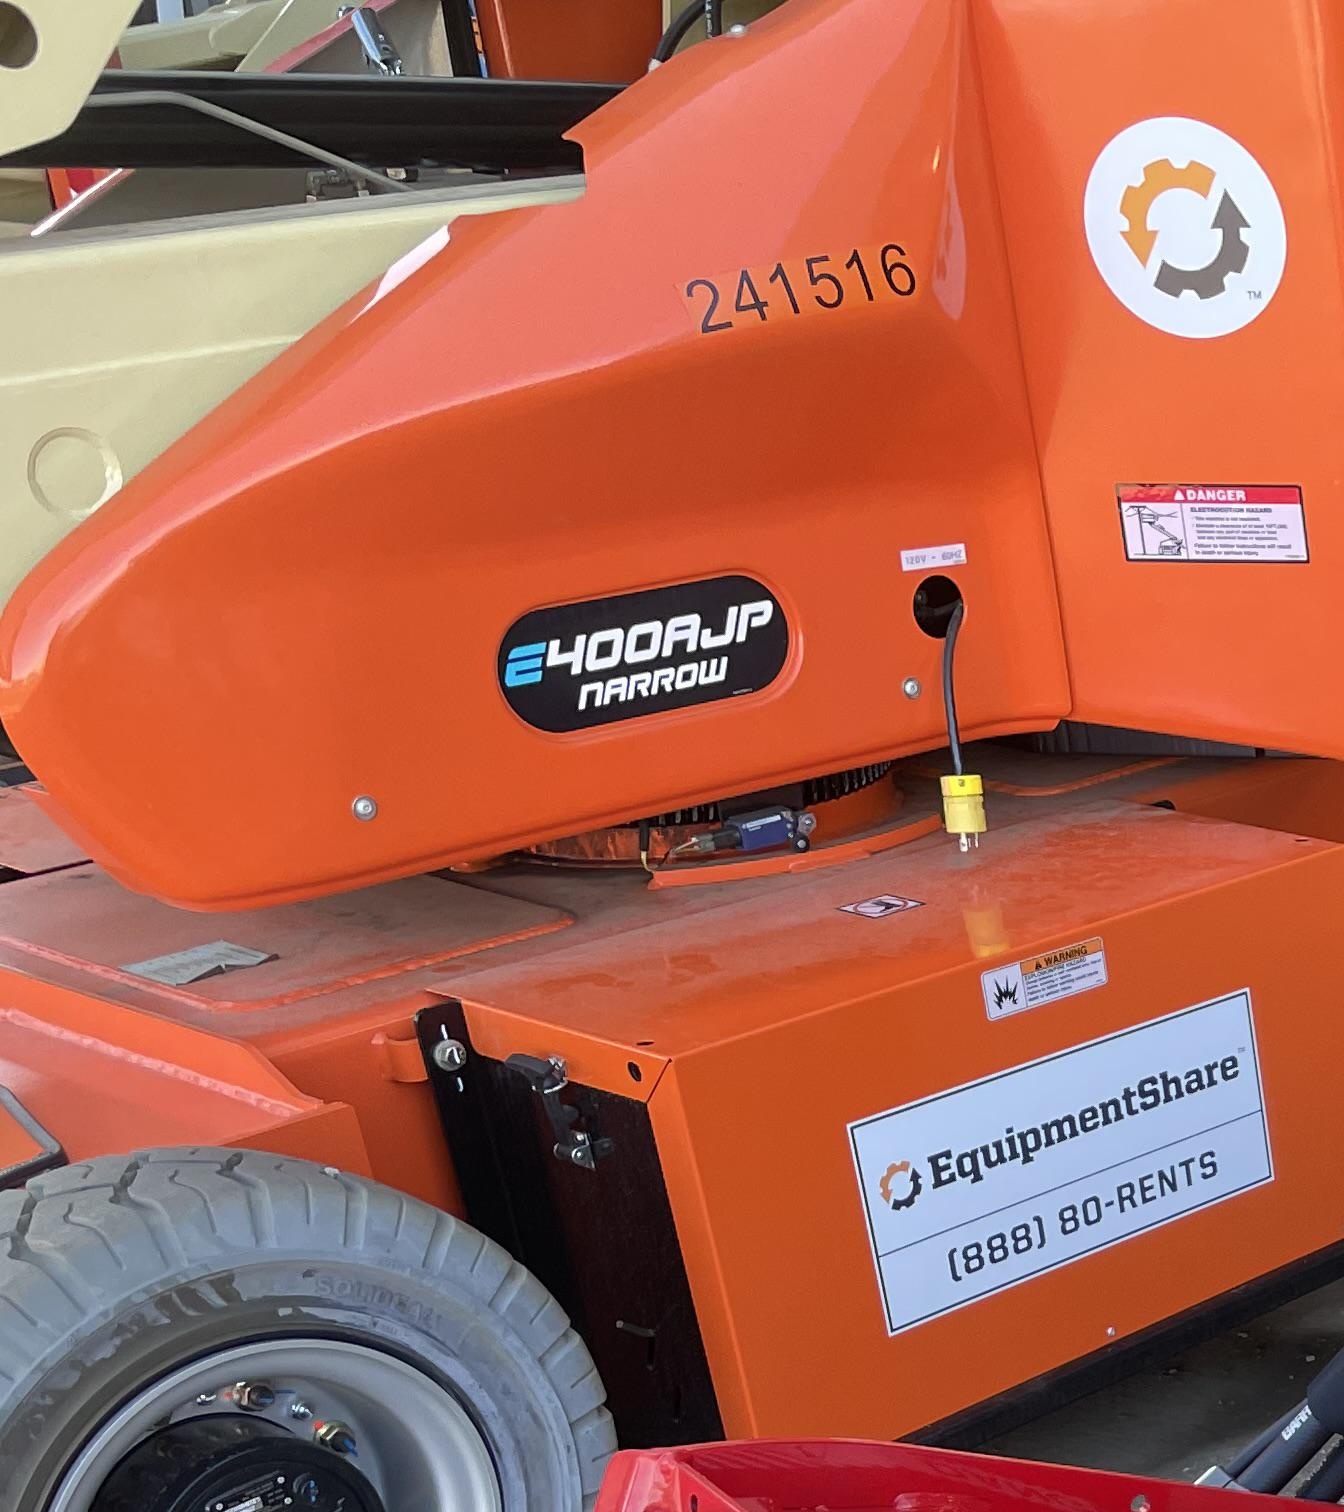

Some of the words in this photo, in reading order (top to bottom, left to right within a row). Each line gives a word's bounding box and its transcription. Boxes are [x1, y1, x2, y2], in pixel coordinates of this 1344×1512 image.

[686, 243, 916, 334] 241516
[1186, 489, 1247, 502] DANGER
[504, 600, 774, 687] E400AJP
[577, 656, 729, 711] NARROW
[1043, 945, 1088, 967] WARNING
[927, 1053, 1240, 1190] EquipmentShare
[947, 1214, 1047, 1283] (888)
[1058, 1149, 1219, 1236] 80-RENTS
